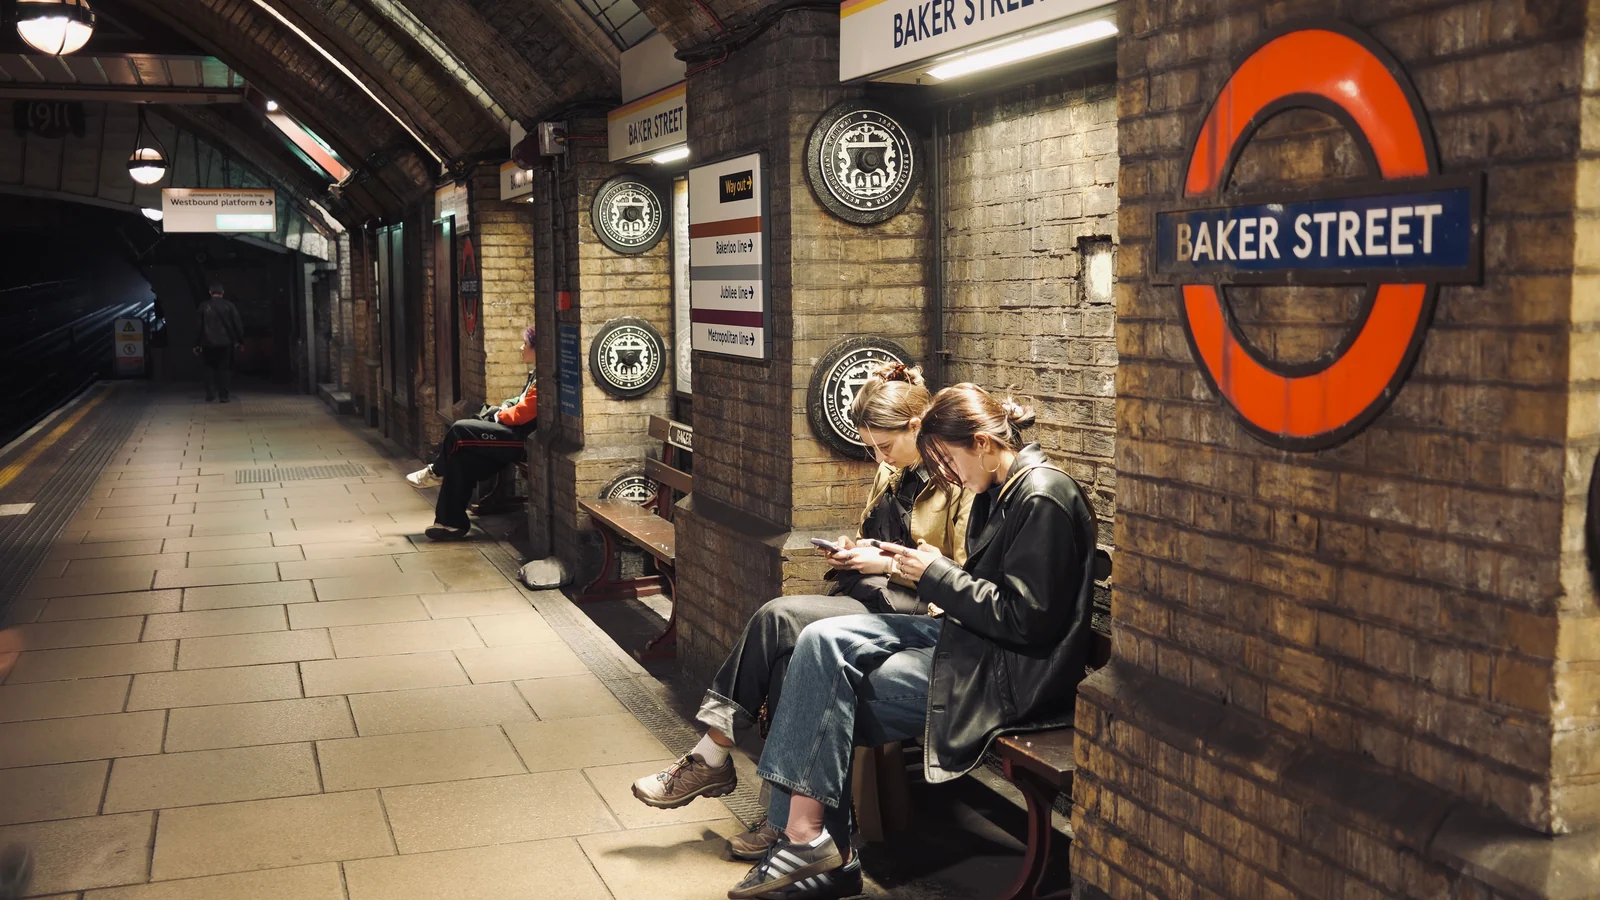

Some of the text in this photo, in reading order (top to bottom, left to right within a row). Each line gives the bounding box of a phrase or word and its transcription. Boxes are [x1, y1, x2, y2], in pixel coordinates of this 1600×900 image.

[893, 0, 957, 48] BAKER
[628, 106, 683, 145] BAKER STREET
[725, 178, 746, 196] Way out
[221, 199, 257, 207] platform
[1177, 204, 1442, 261] BAKER STREET
[716, 239, 747, 254] Bakerloo line
[720, 285, 748, 300] Jubilee line
[707, 328, 749, 346] Metropolitan line
[832, 355, 858, 383] RAILWAY
